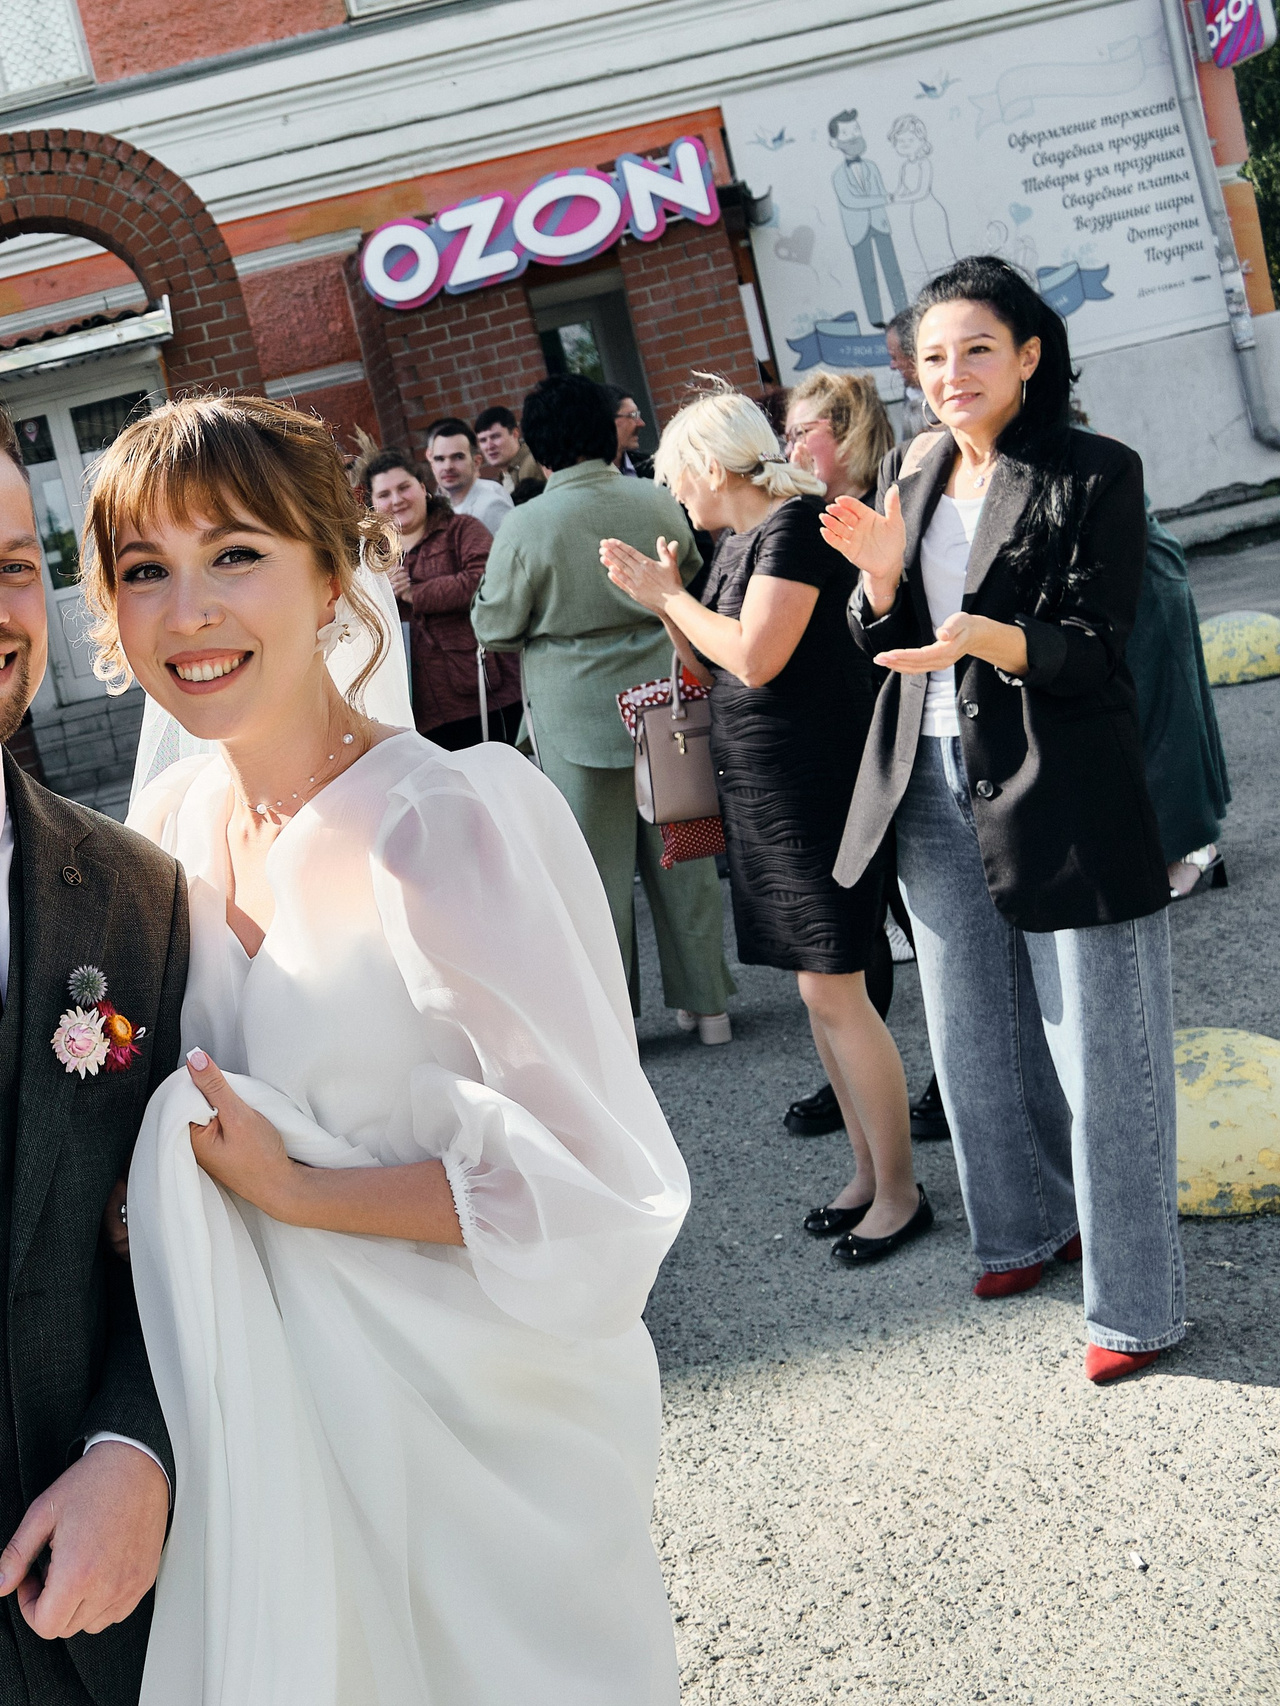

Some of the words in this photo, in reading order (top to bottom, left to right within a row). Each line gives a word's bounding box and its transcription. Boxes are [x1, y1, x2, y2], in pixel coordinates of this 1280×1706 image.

[1206, 0, 1254, 48] OZO
[1007, 118, 1097, 153] Оформление
[1100, 97, 1177, 129] торжеств
[1032, 141, 1105, 168] Свадебная
[1108, 122, 1181, 154] продукция
[1021, 171, 1081, 196] Товары
[1084, 163, 1110, 186] для
[1114, 146, 1186, 177] праздника
[1062, 182, 1134, 211] Свадебные
[1137, 170, 1191, 192] платья
[363, 141, 712, 302] OZON
[1073, 202, 1151, 234] Воздушные
[1154, 193, 1195, 215] шары
[1127, 217, 1200, 244] Фотозоны
[1144, 239, 1204, 264] Подарки
